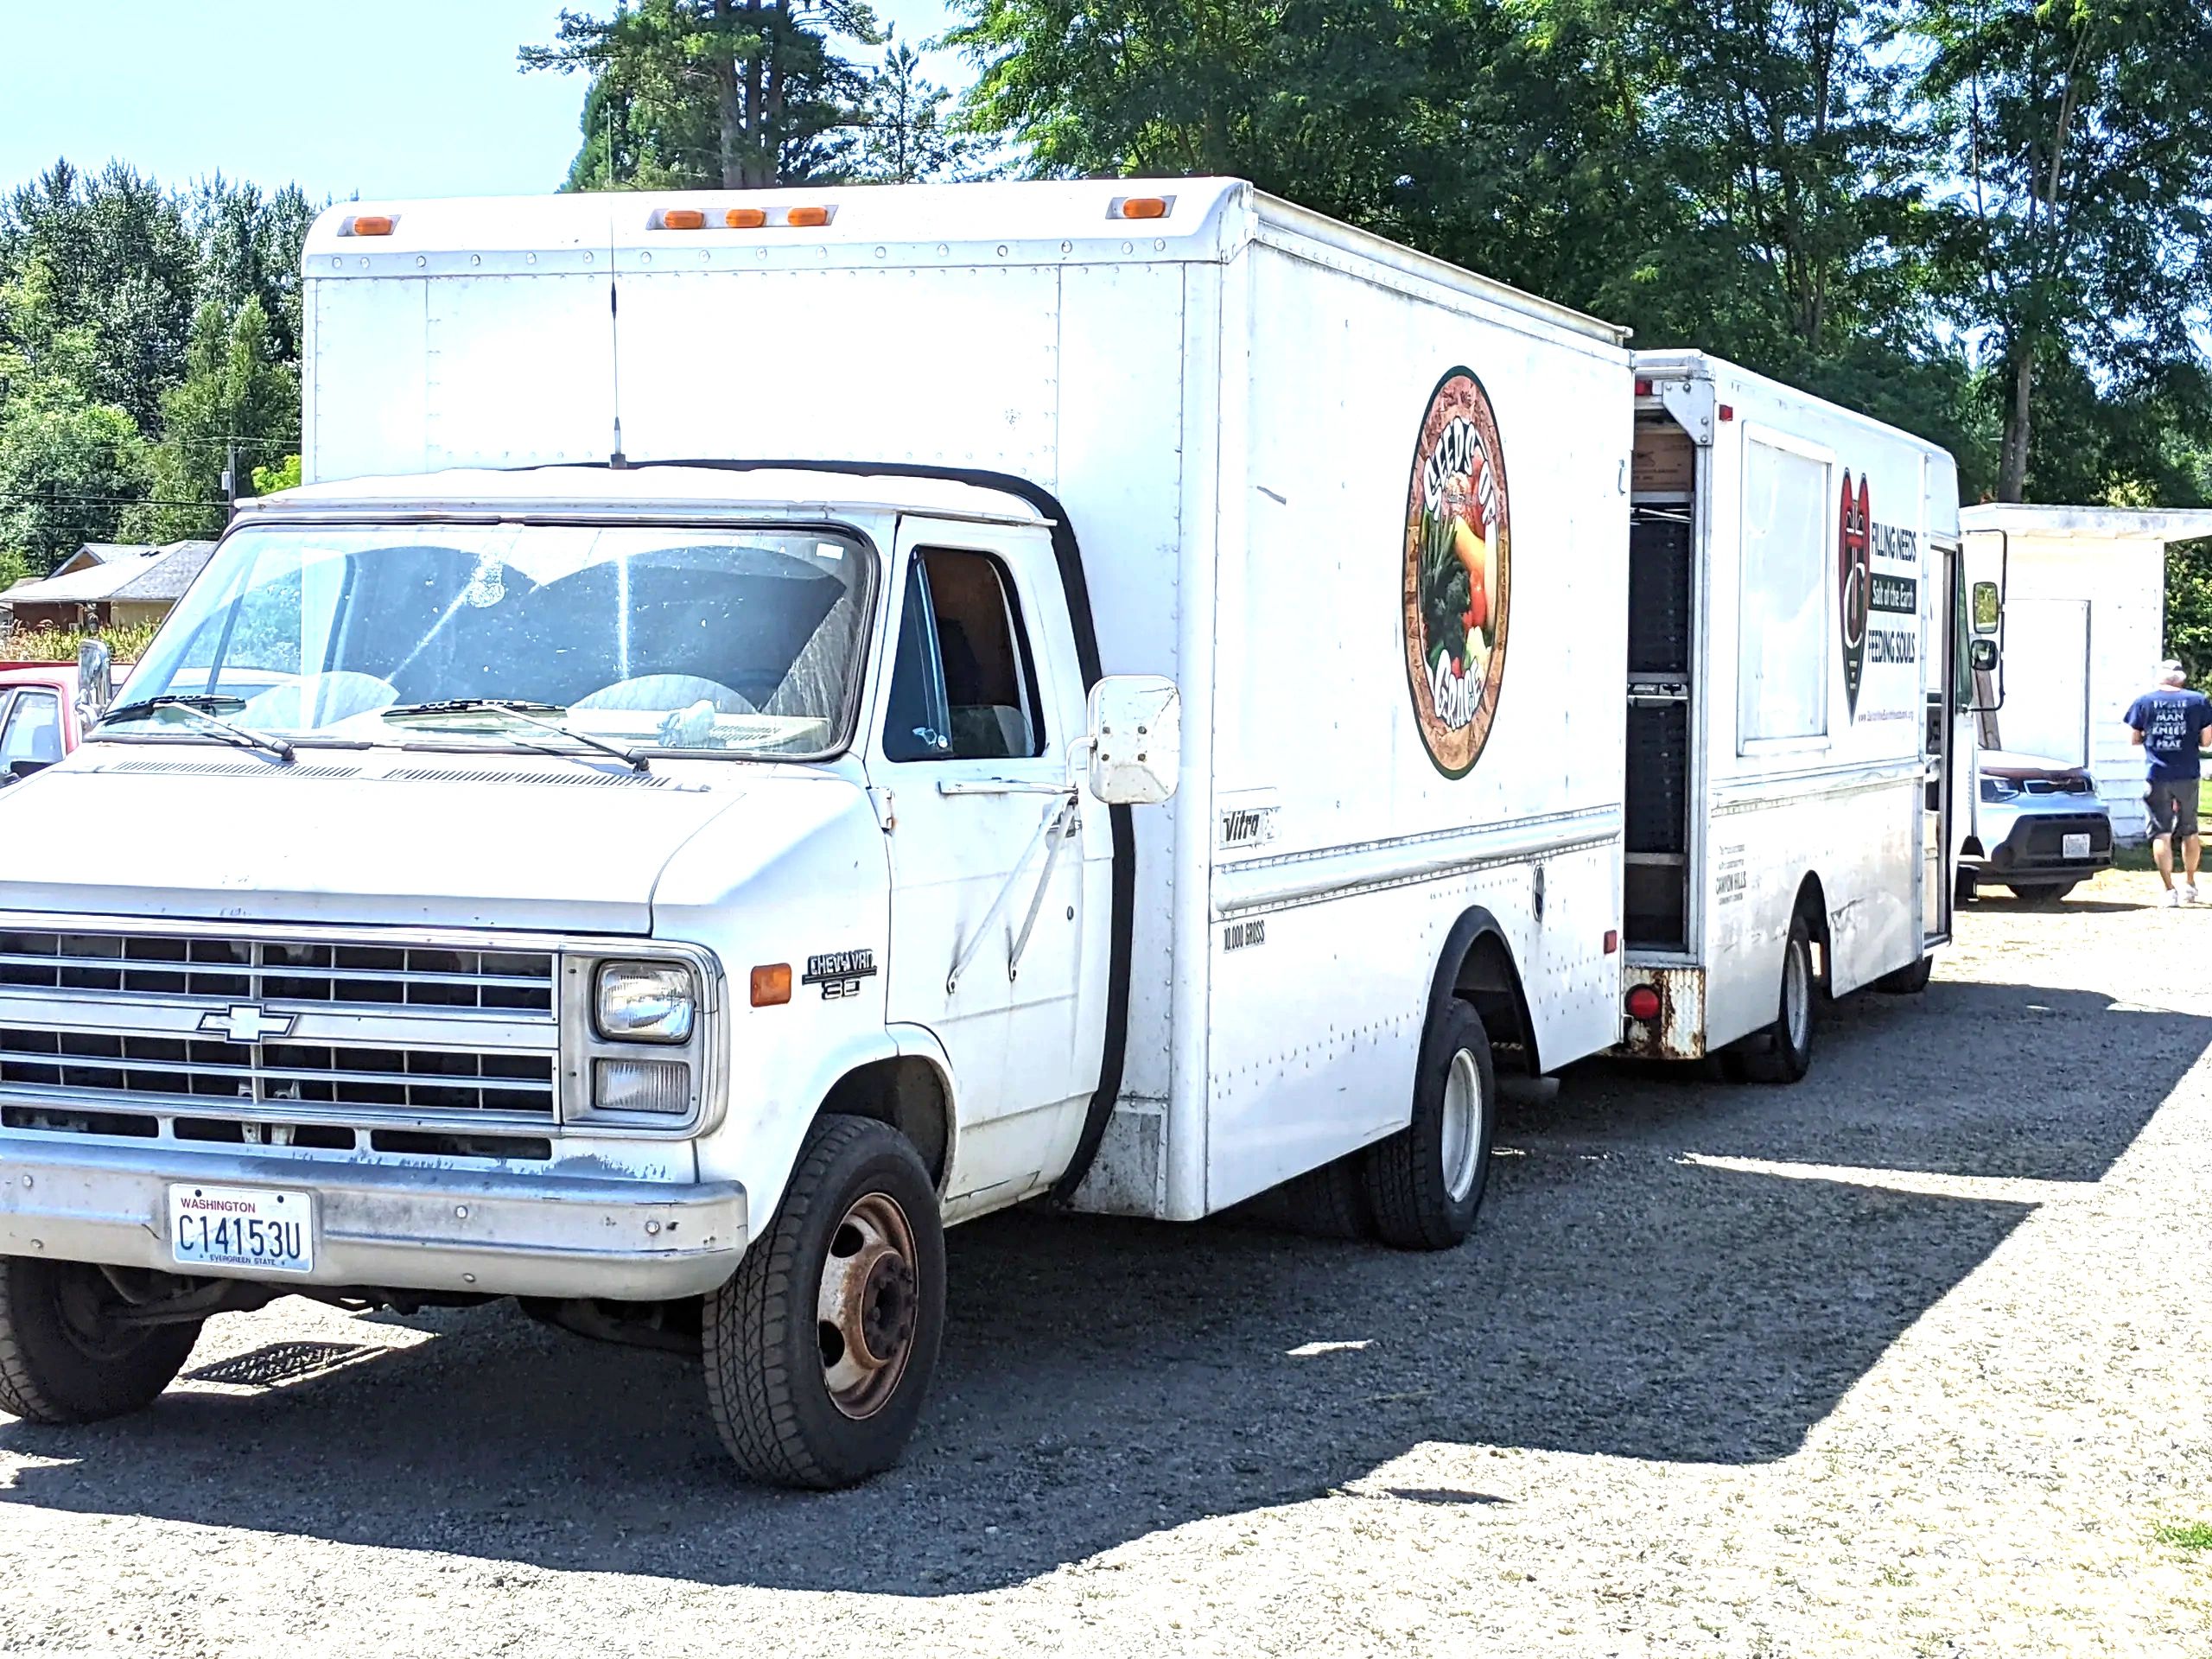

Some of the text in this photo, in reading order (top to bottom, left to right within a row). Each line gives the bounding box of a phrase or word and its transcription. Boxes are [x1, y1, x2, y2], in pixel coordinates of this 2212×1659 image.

[1422, 415, 1497, 525] SEEDS OF
[1871, 521, 1916, 563] FILLING NEEDS
[1872, 579, 1914, 609] Salt of the Earth
[1867, 628, 1916, 664] FEEDING SOULS
[1434, 648, 1483, 732] GRACE
[2156, 712, 2184, 722] MAN
[1244, 918, 1265, 947] GROSS
[808, 951, 850, 976] CHEVY
[180, 1198, 256, 1213] WASHINGTON
[179, 1214, 301, 1260] C14153U
[209, 1253, 276, 1266] EVERGREEN STATE
